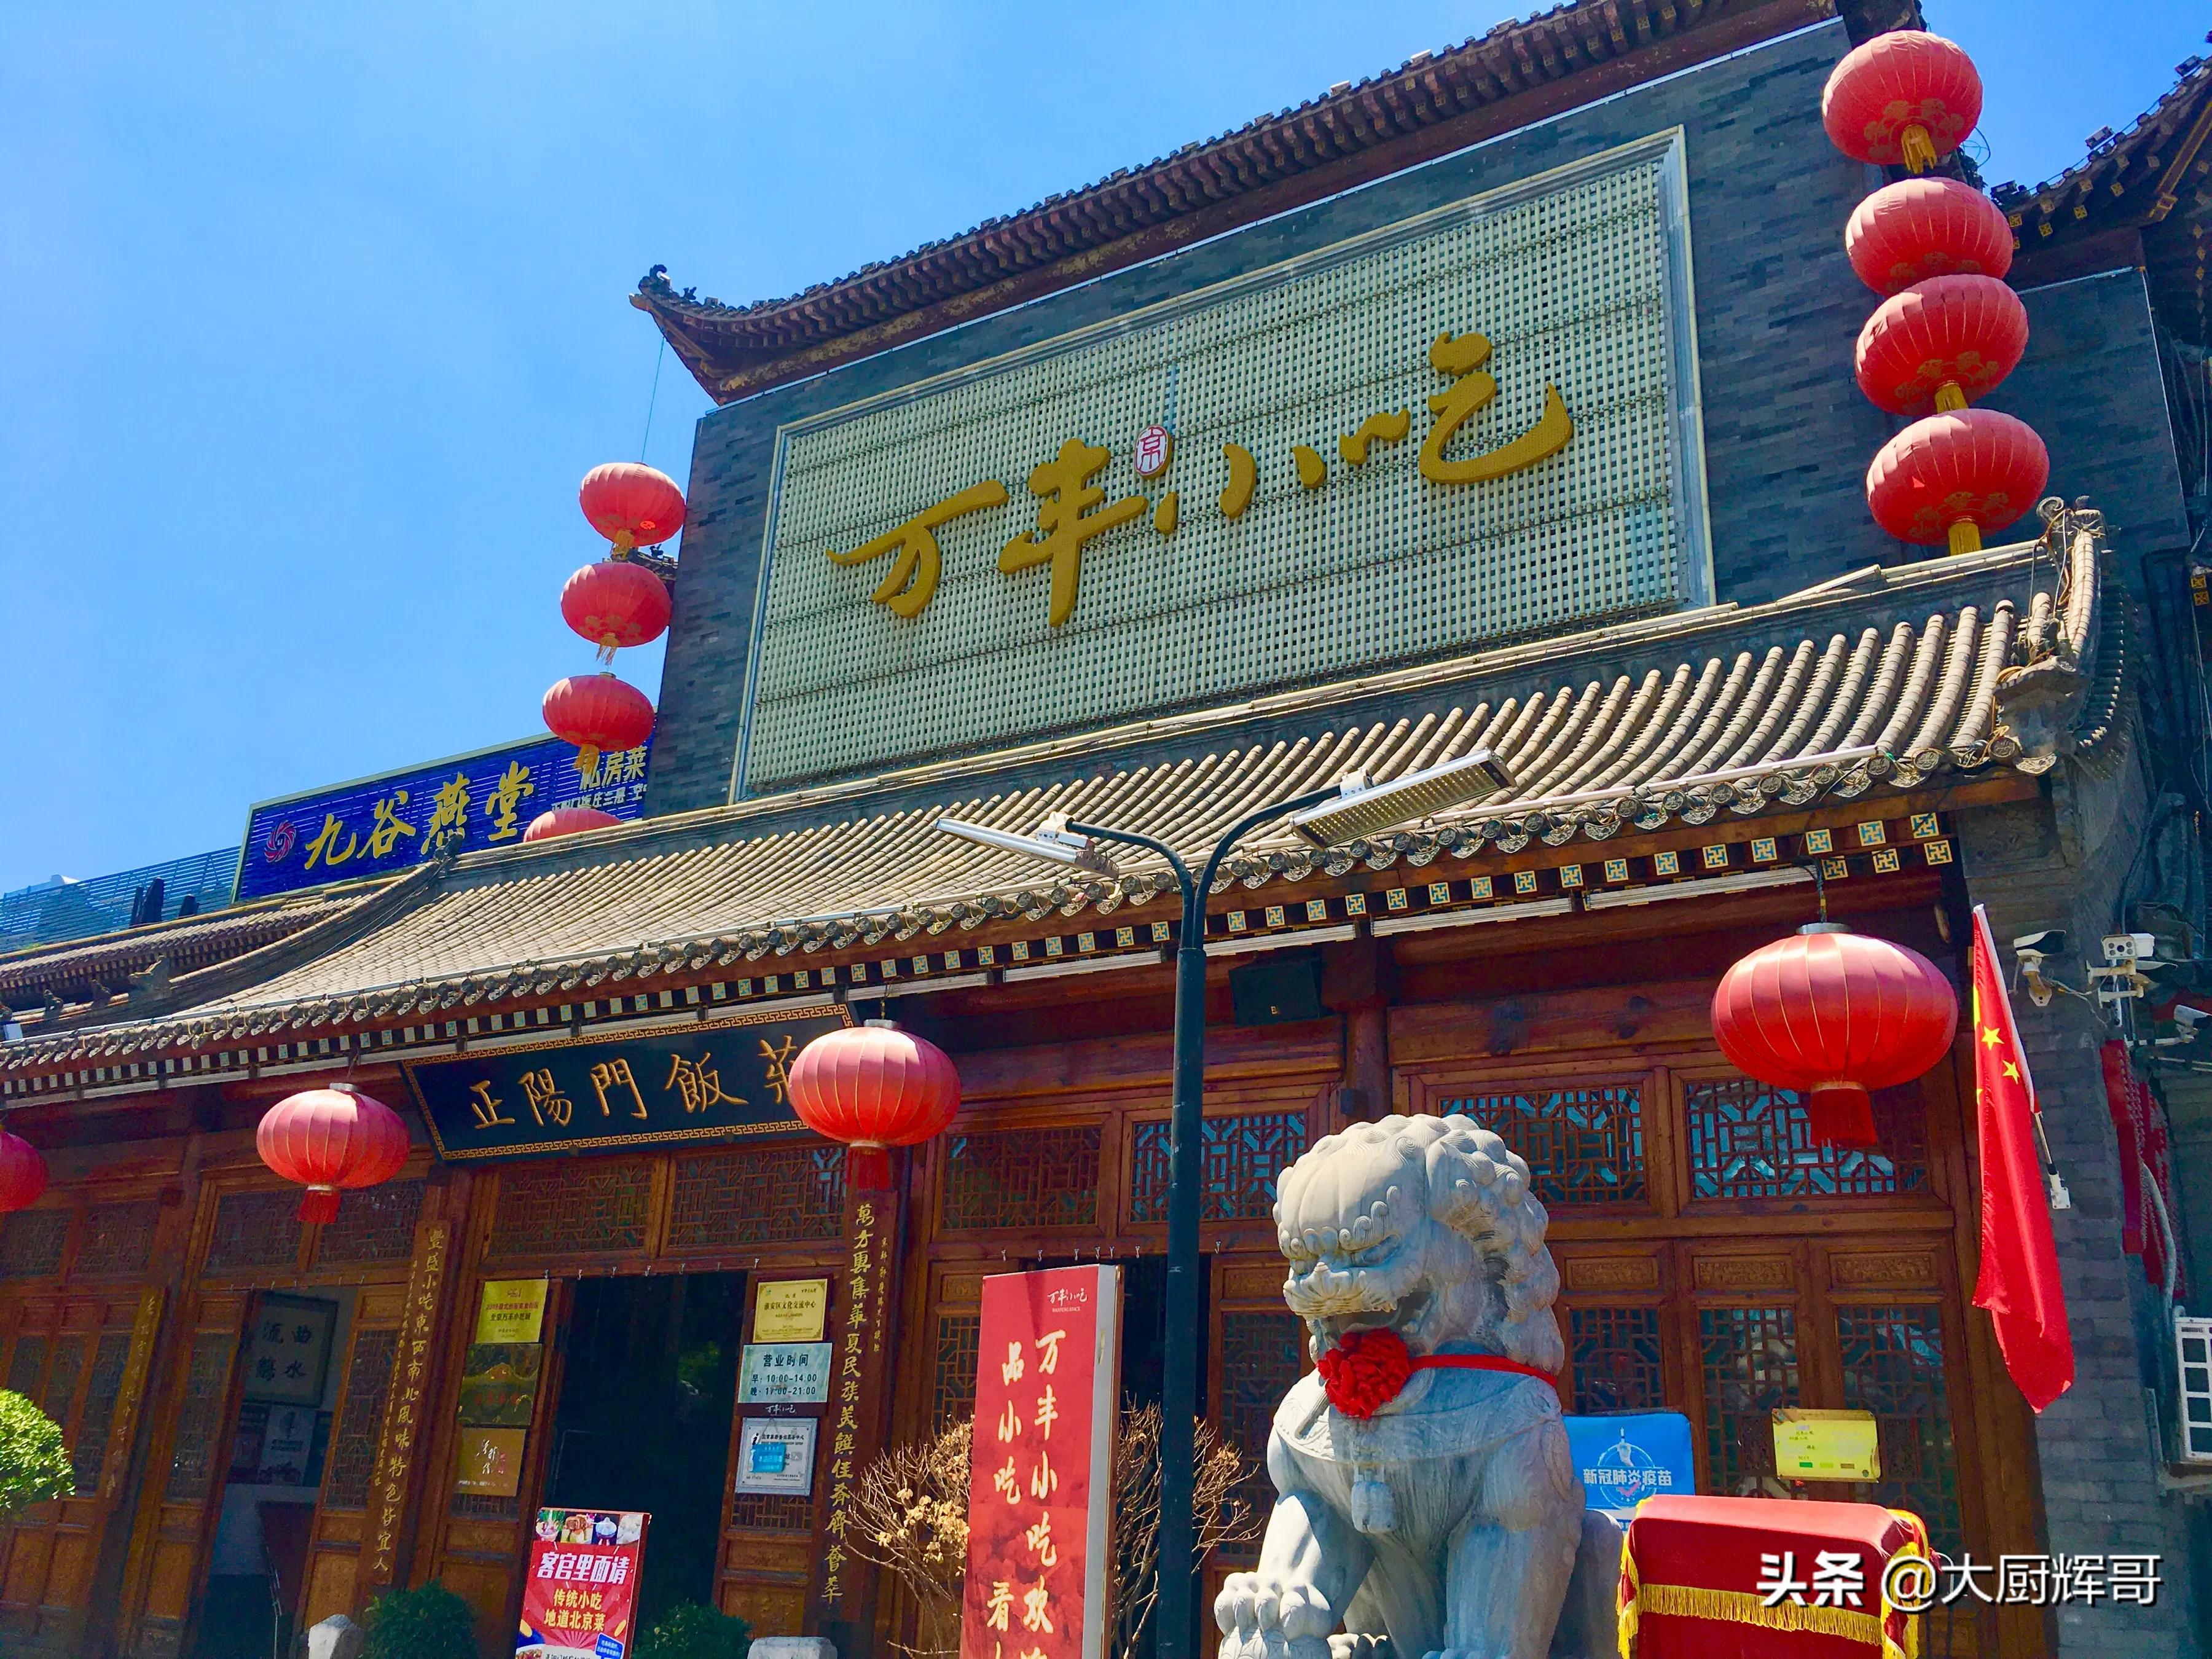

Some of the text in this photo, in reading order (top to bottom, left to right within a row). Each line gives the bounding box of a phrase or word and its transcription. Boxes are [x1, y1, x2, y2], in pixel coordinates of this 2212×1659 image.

[825, 332, 1574, 627] 万丰小吃
[304, 761, 535, 870] 九谷燕堂
[763, 1353, 809, 1368] 营业时间
[767, 1373, 817, 1383] 10:00-14:00
[1583, 1469, 1673, 1486] 新冠肺炎疫苗
[986, 1341, 1026, 1659] 品小吃看
[536, 1551, 630, 1584] 客官里面请
[554, 1588, 603, 1610] 传统小吃
[543, 1609, 606, 1631] 地道北京菜
